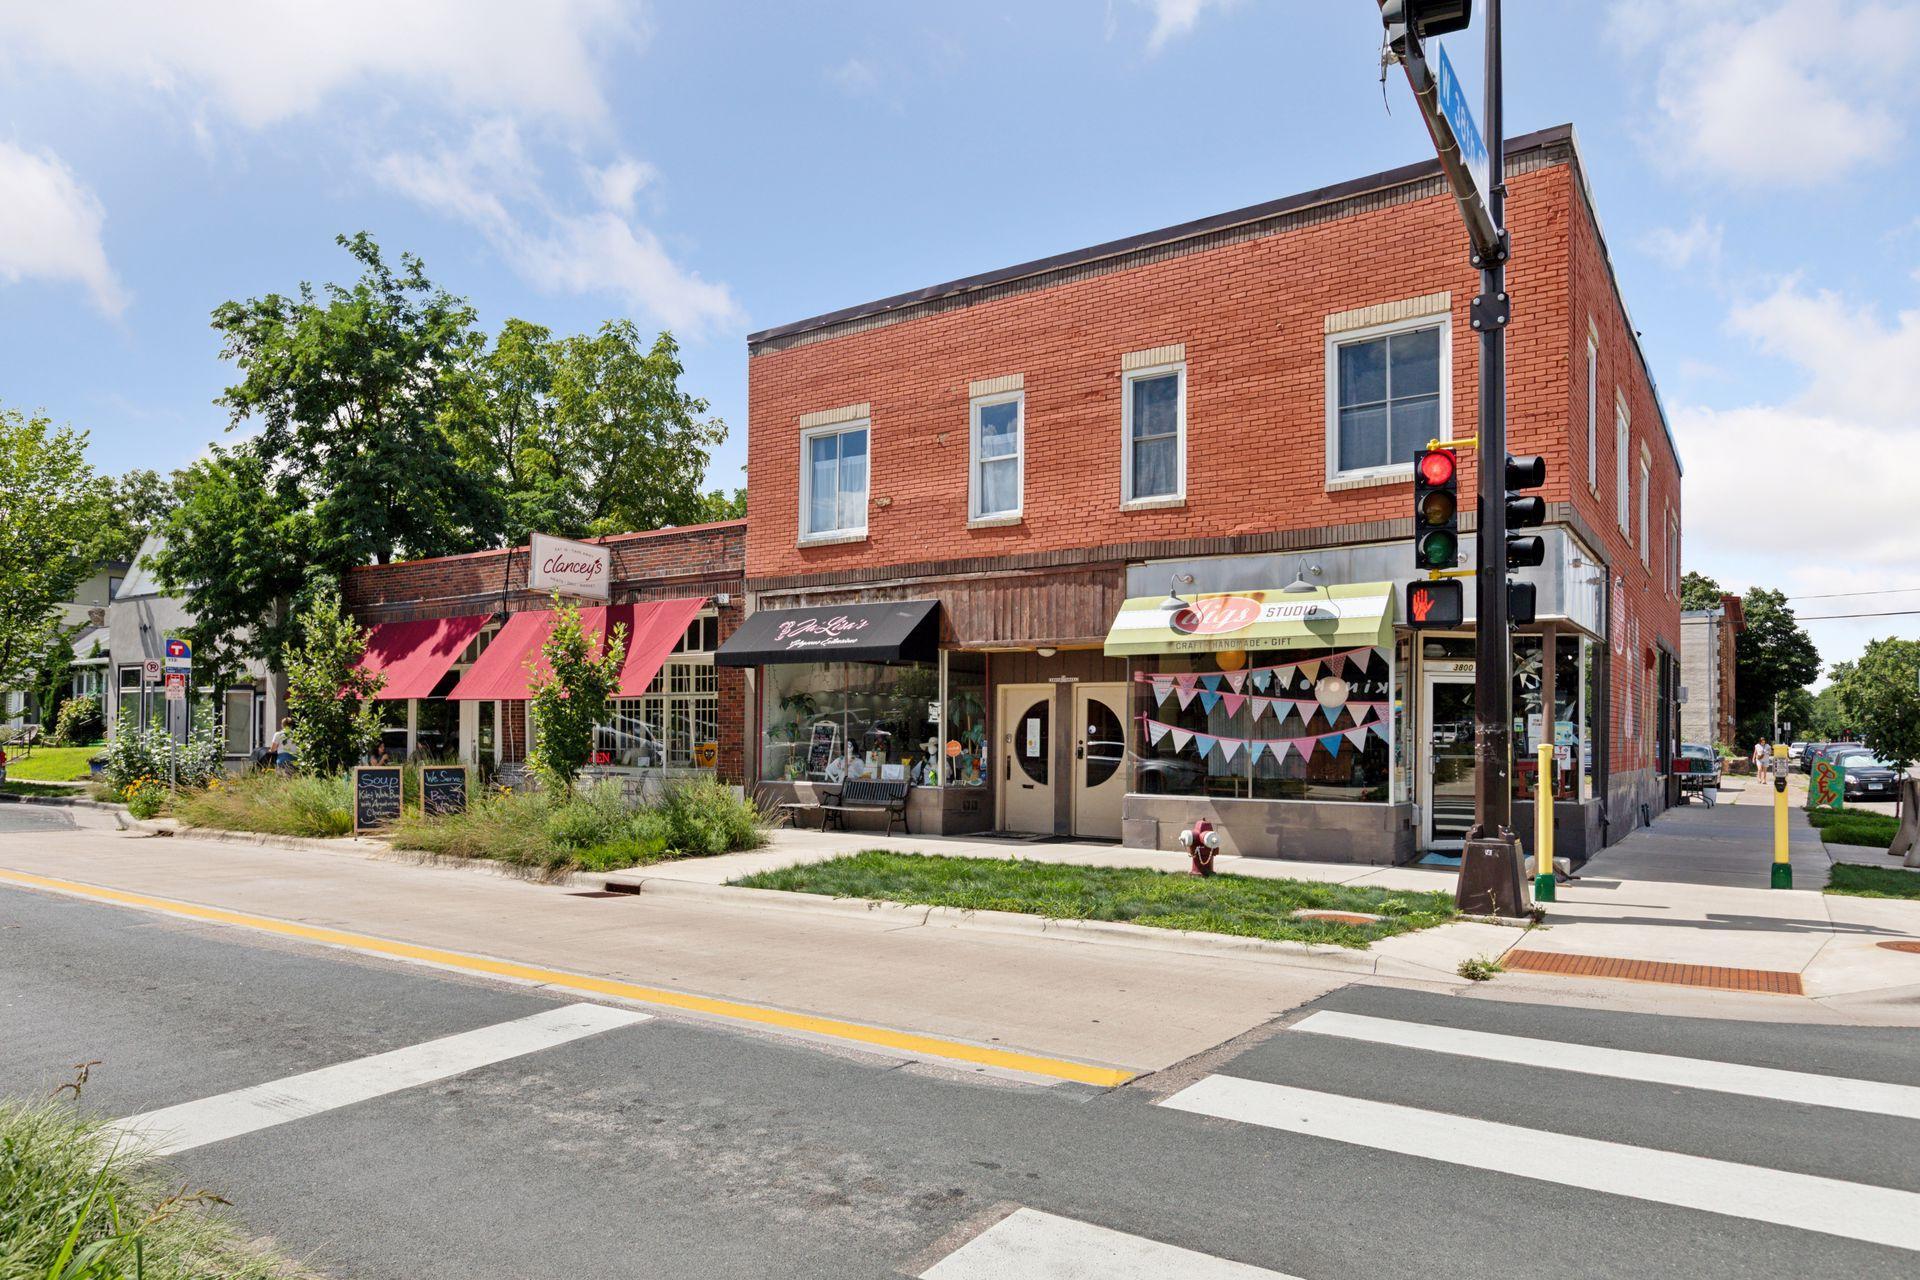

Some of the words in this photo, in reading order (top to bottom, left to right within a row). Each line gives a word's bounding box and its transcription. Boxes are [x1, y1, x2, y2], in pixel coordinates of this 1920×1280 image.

[1441, 59, 1451, 107] W
[543, 554, 603, 581] Clancey's
[1181, 604, 1249, 629] digs
[1266, 605, 1317, 617] STUDIO
[1175, 642, 1202, 650] CRAFT
[1212, 638, 1261, 649] HANDMADE
[1271, 637, 1292, 646] GIFT
[1453, 663, 1474, 672] 3800
[361, 773, 399, 789] Soup
[425, 771, 438, 783] We
